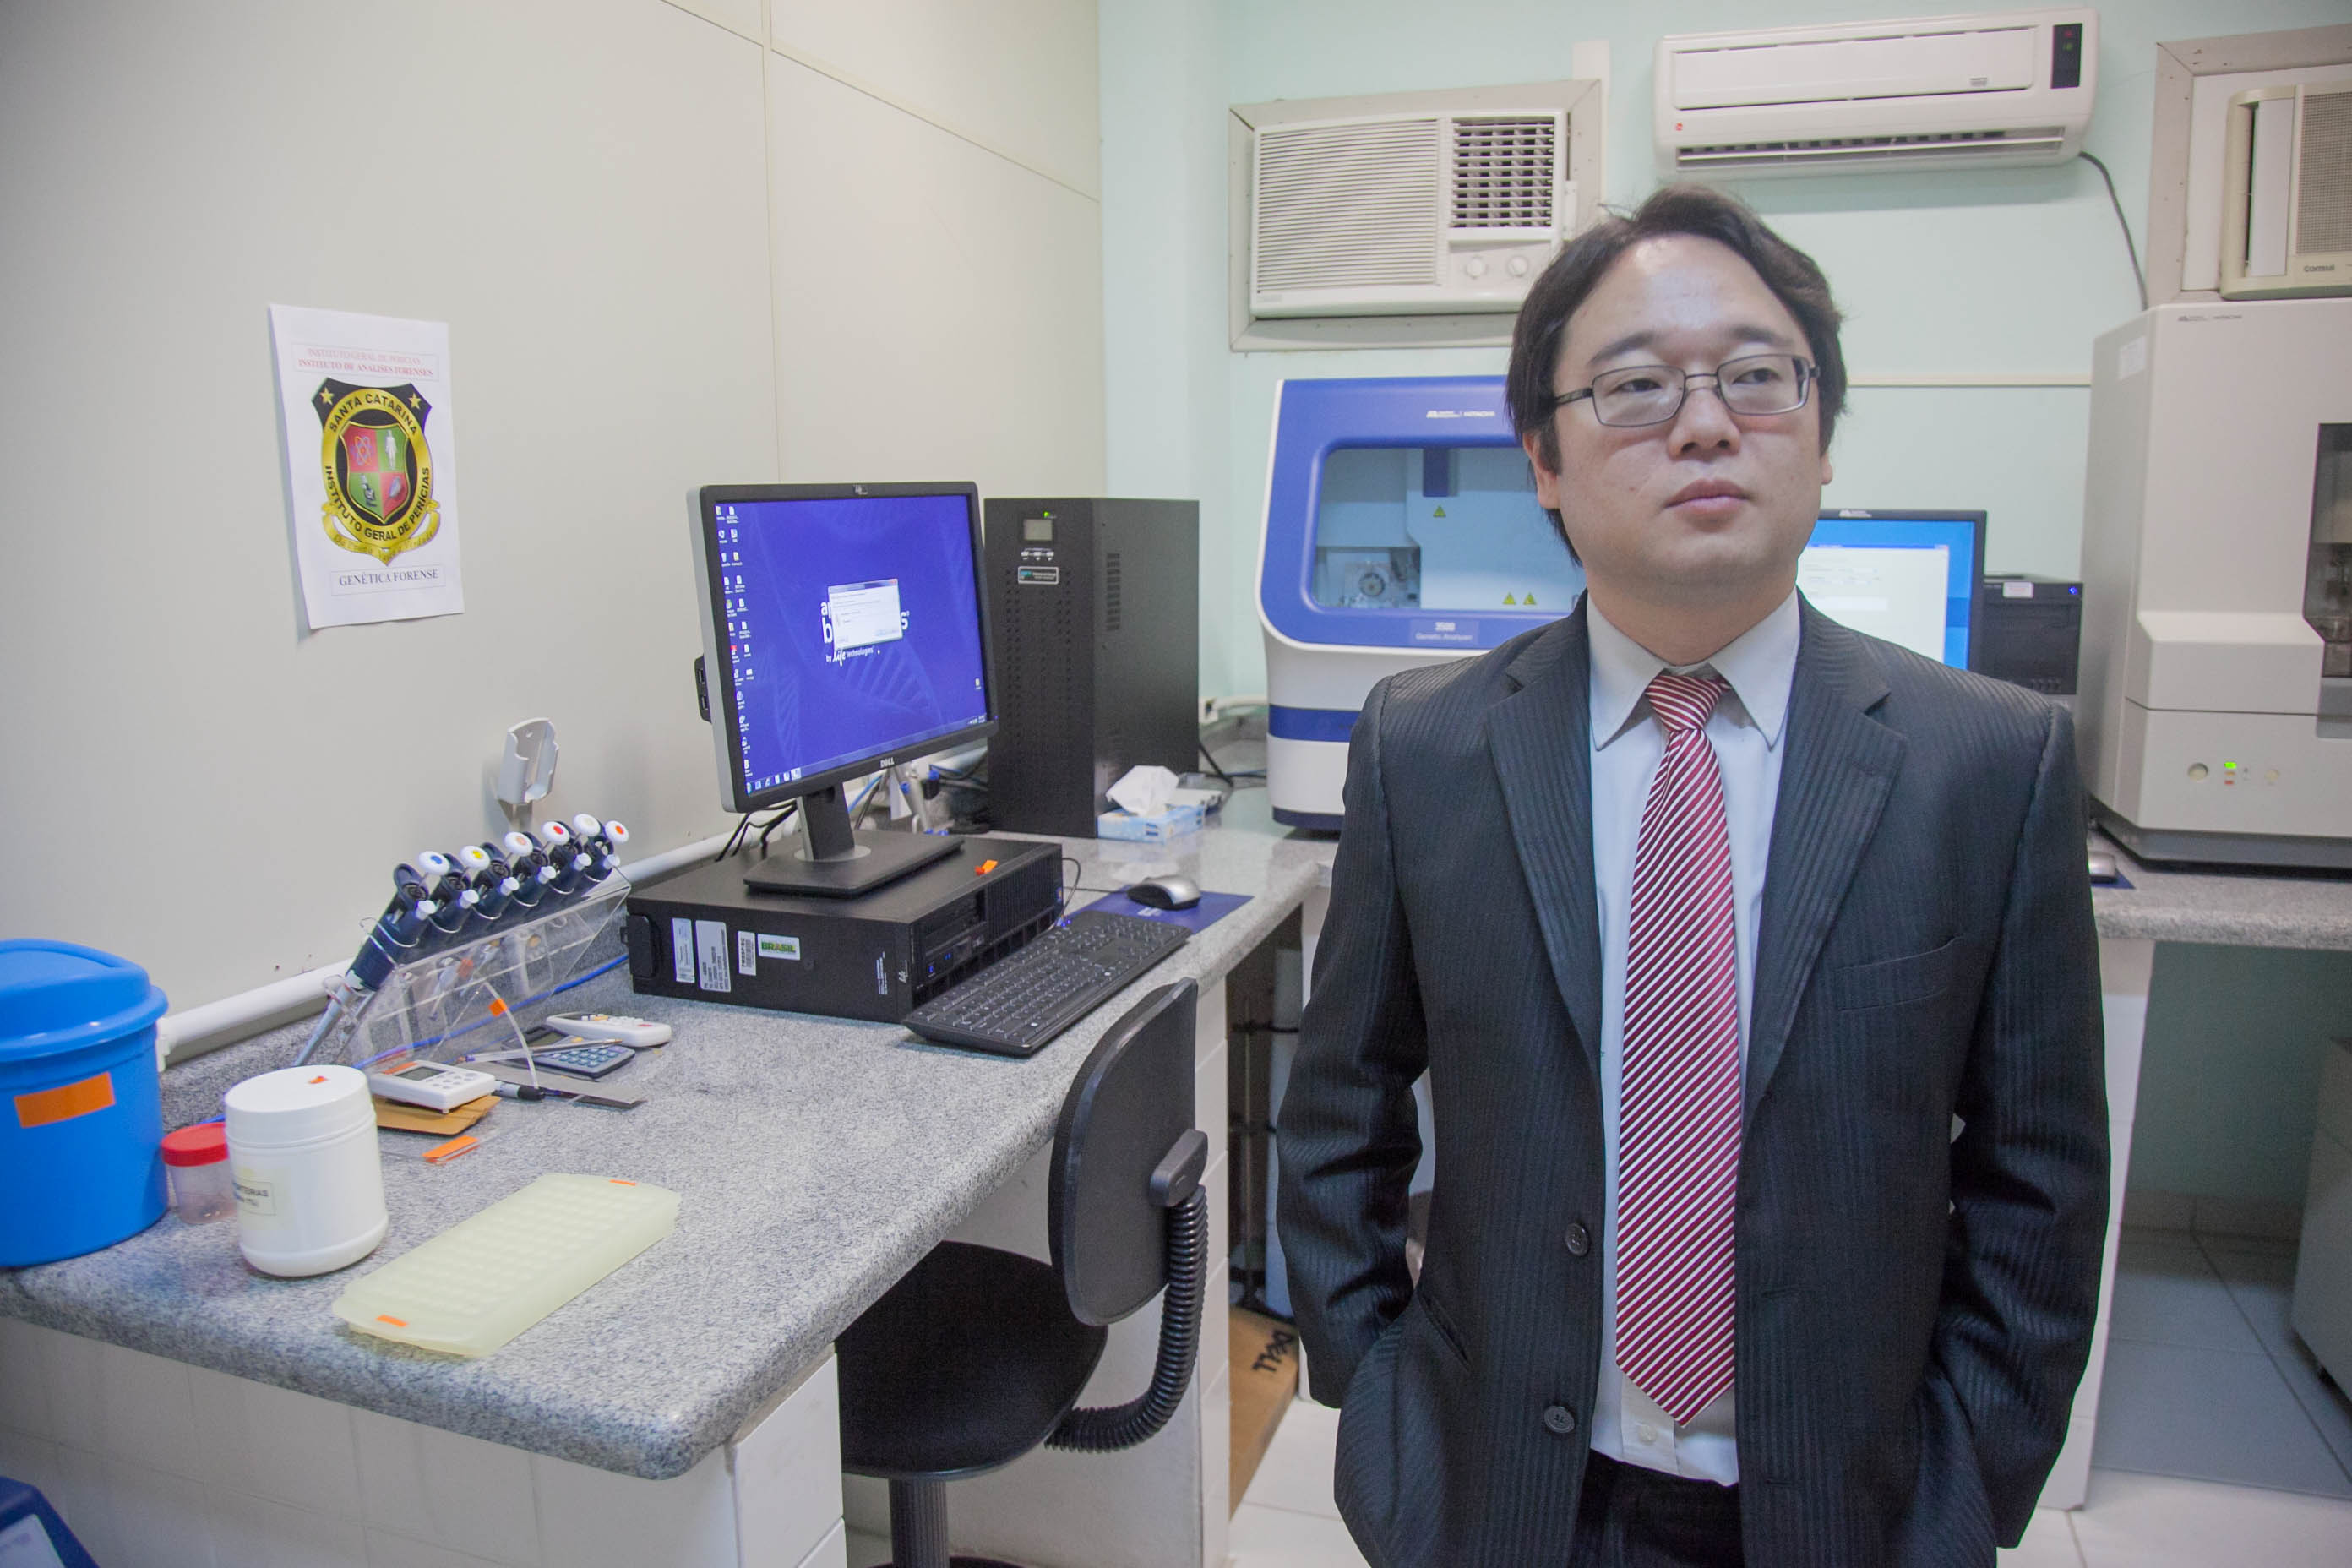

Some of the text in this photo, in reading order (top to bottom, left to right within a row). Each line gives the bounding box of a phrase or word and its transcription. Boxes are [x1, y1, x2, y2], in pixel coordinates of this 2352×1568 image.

[298, 358, 343, 370] INSTITUTO
[395, 366, 433, 377] FORENSES
[329, 393, 417, 434] SANTA CATARINA
[325, 466, 362, 532] INSTITUTO
[364, 527, 397, 542] GERAL
[398, 521, 411, 536] DE
[339, 569, 438, 586] GENÉTICA FORENSE
[880, 757, 895, 768] DELL
[761, 941, 797, 953] BRASIL
